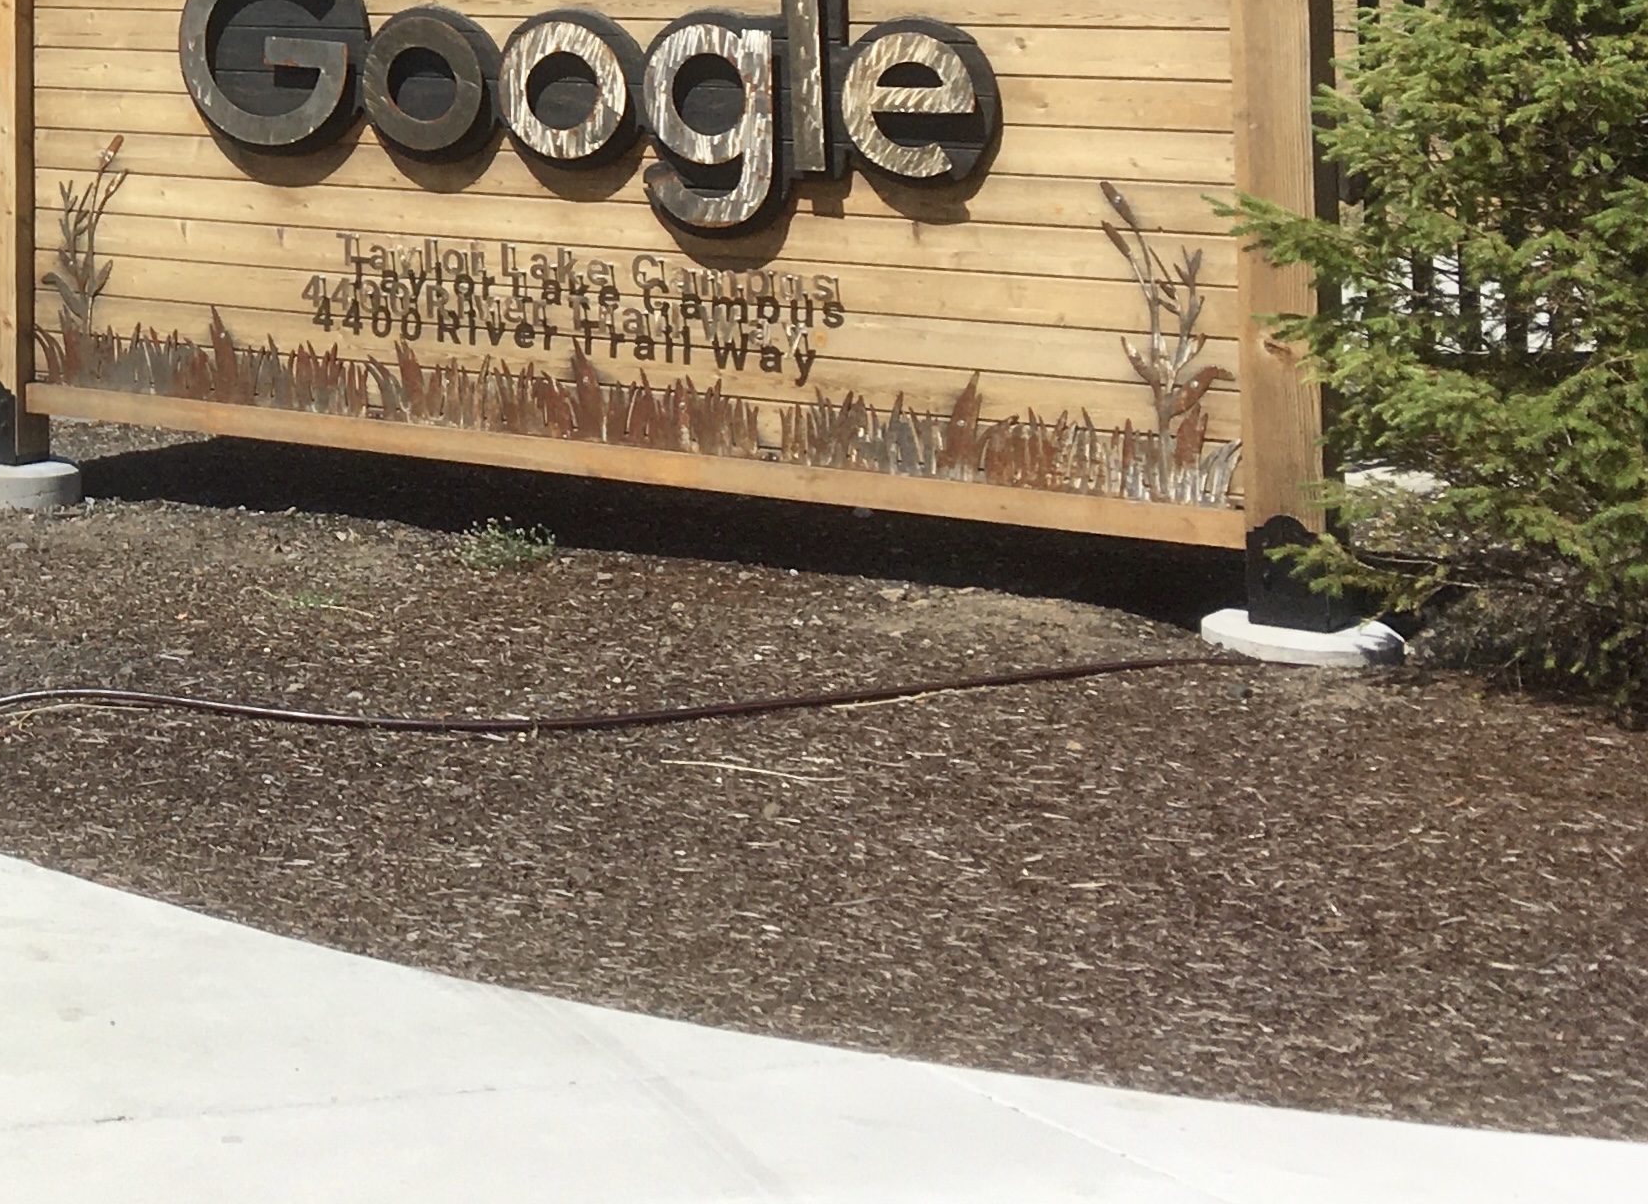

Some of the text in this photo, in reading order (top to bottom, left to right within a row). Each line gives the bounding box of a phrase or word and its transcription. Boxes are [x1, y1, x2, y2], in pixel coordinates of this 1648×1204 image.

[336, 232, 837, 304] Taylor Lake Campus
[301, 274, 805, 359] 4400 River Trail Way
